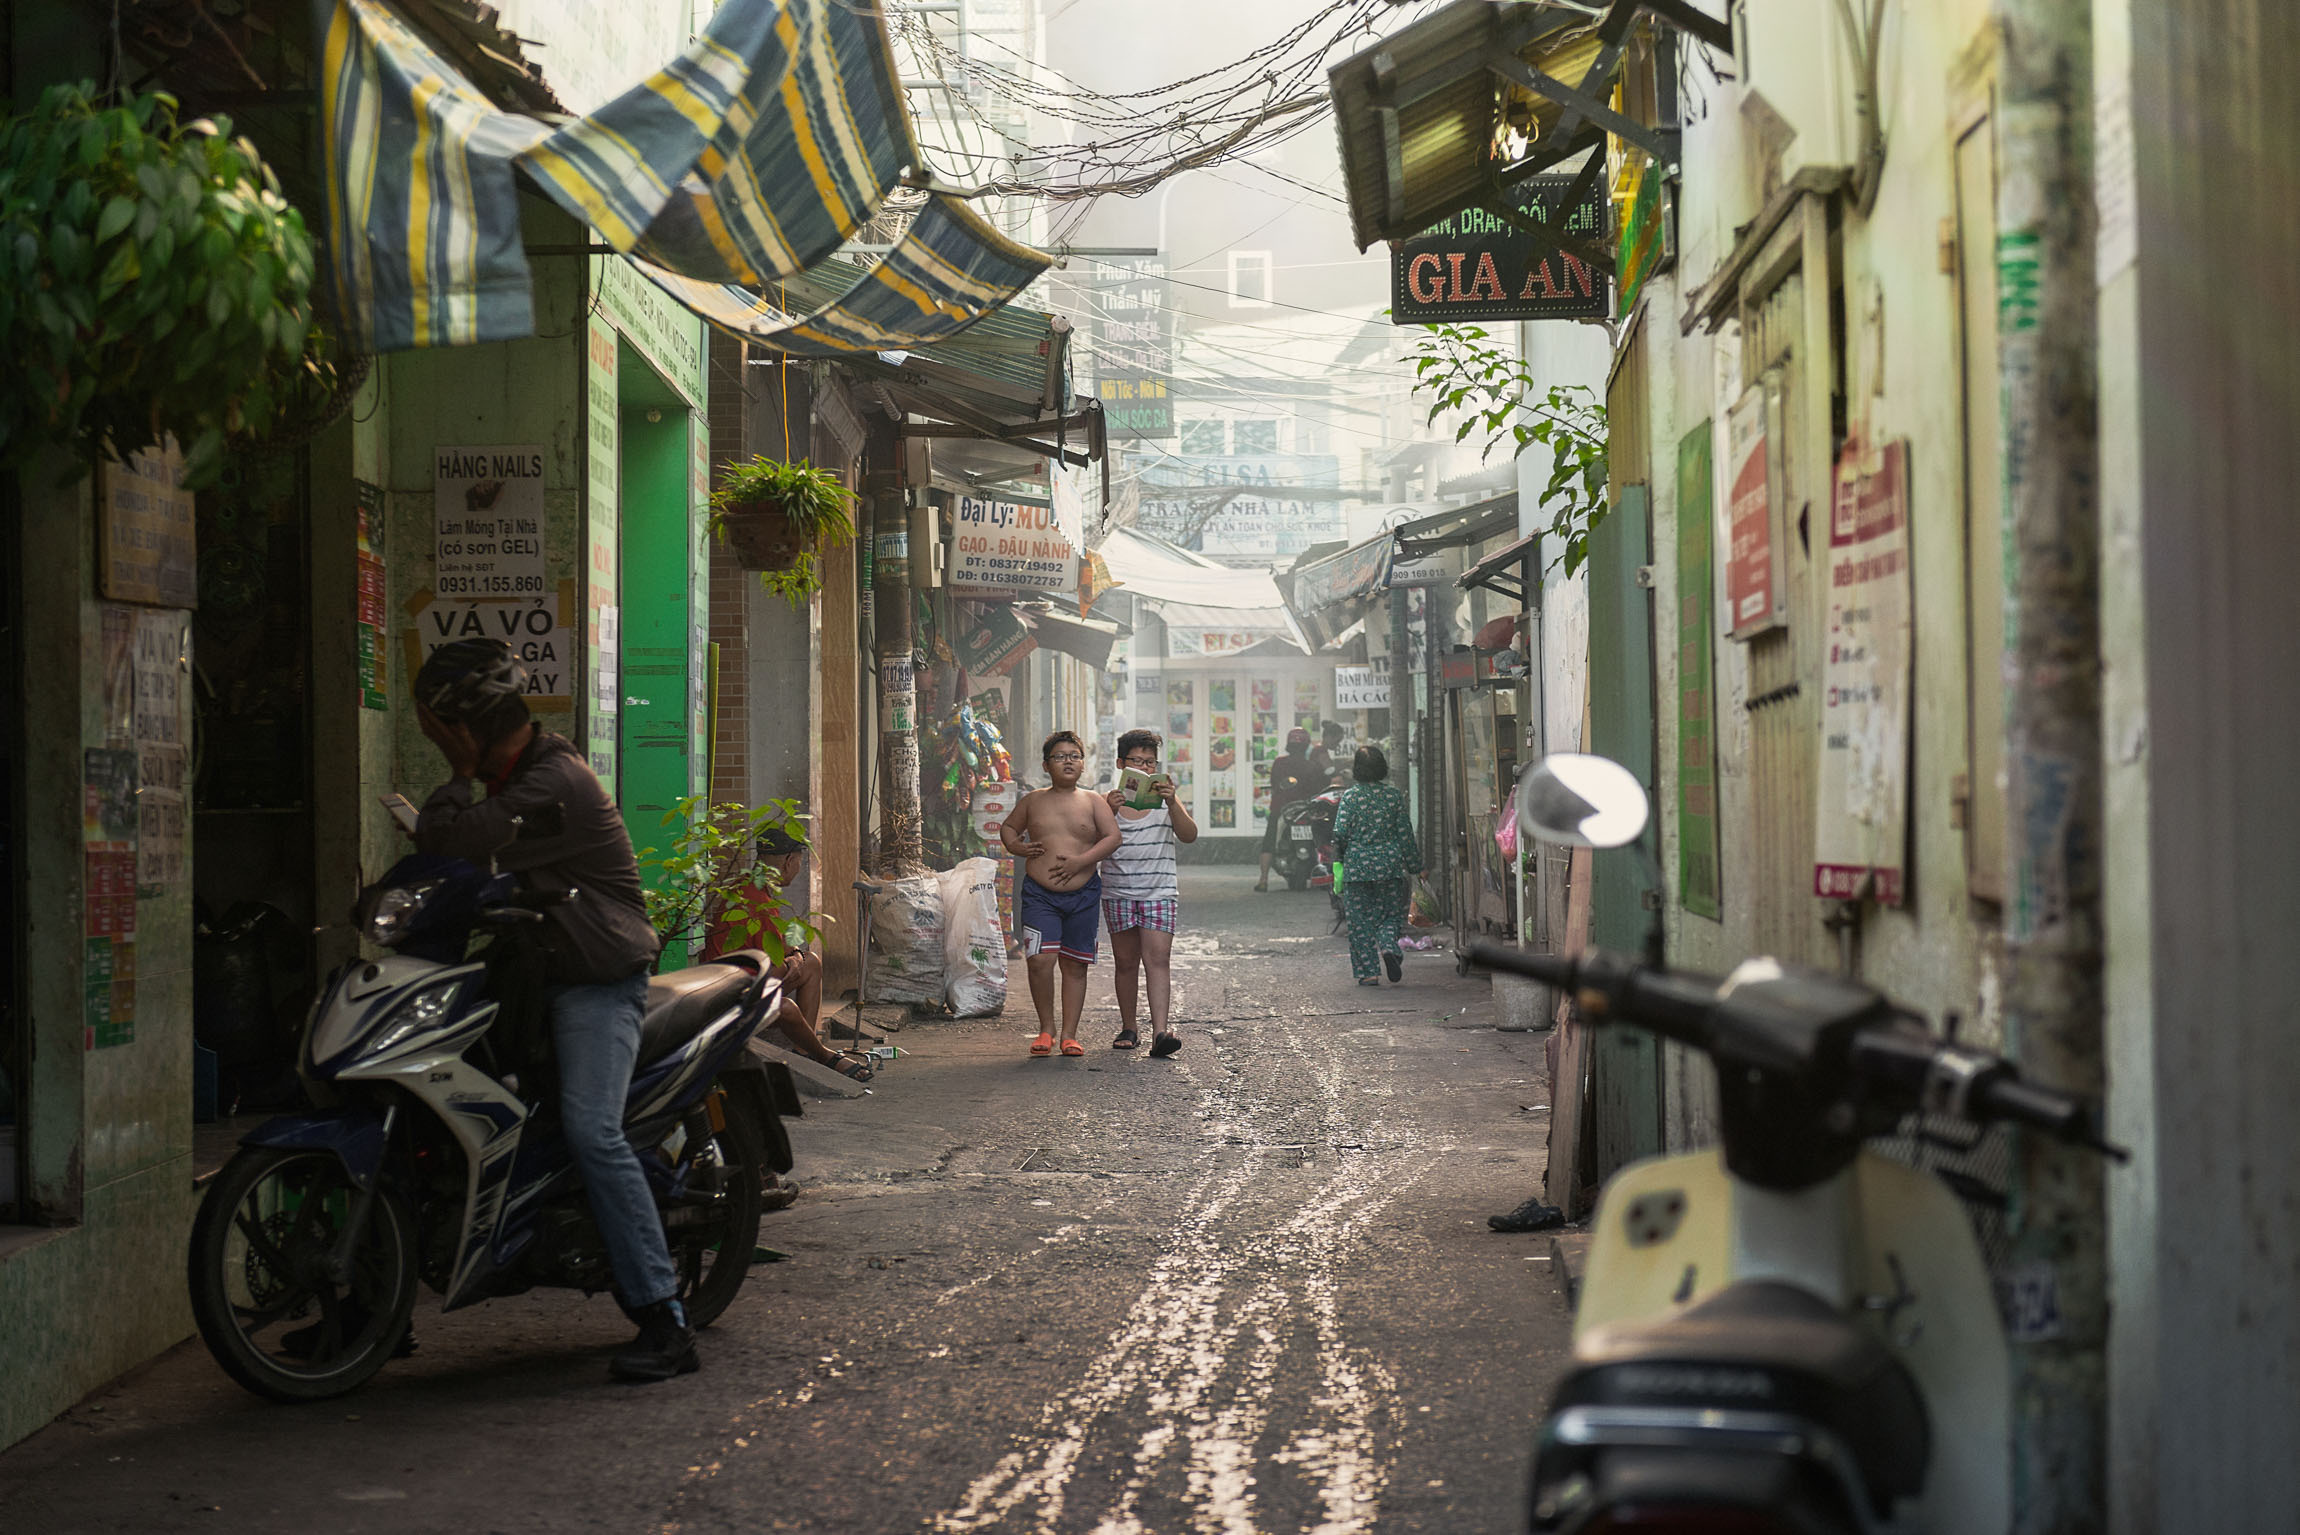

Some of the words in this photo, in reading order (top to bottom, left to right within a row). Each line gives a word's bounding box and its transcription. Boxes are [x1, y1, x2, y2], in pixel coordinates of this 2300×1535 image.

[1096, 261, 1133, 280] Phun
[1135, 259, 1165, 280] Xăm
[1408, 252, 1507, 304] GIA
[1131, 404, 1151, 430] SÓC
[493, 455, 542, 478] NAILS
[961, 496, 985, 527] Đại
[991, 501, 1013, 528] Lý:
[465, 519, 495, 537] Móng
[497, 519, 513, 538] Tại
[516, 519, 537, 534] Nhà
[439, 540, 463, 559] (có
[467, 543, 496, 555] sơn
[501, 539, 539, 558] GEL)
[959, 535, 988, 556] GẠO
[998, 535, 1027, 558] ĐẬU
[1032, 537, 1071, 560] NÀNH
[966, 557, 985, 568] ĐT:
[989, 558, 1063, 573] 0837719492
[1412, 570, 1427, 578] 169
[439, 576, 543, 593] 0931.155.860
[957, 570, 977, 580] DĐ:
[981, 571, 1064, 587] 01638072787
[432, 603, 485, 637] VÁ
[498, 599, 554, 636] VỎ
[522, 641, 557, 662] GA
[519, 669, 559, 695] ÁY
